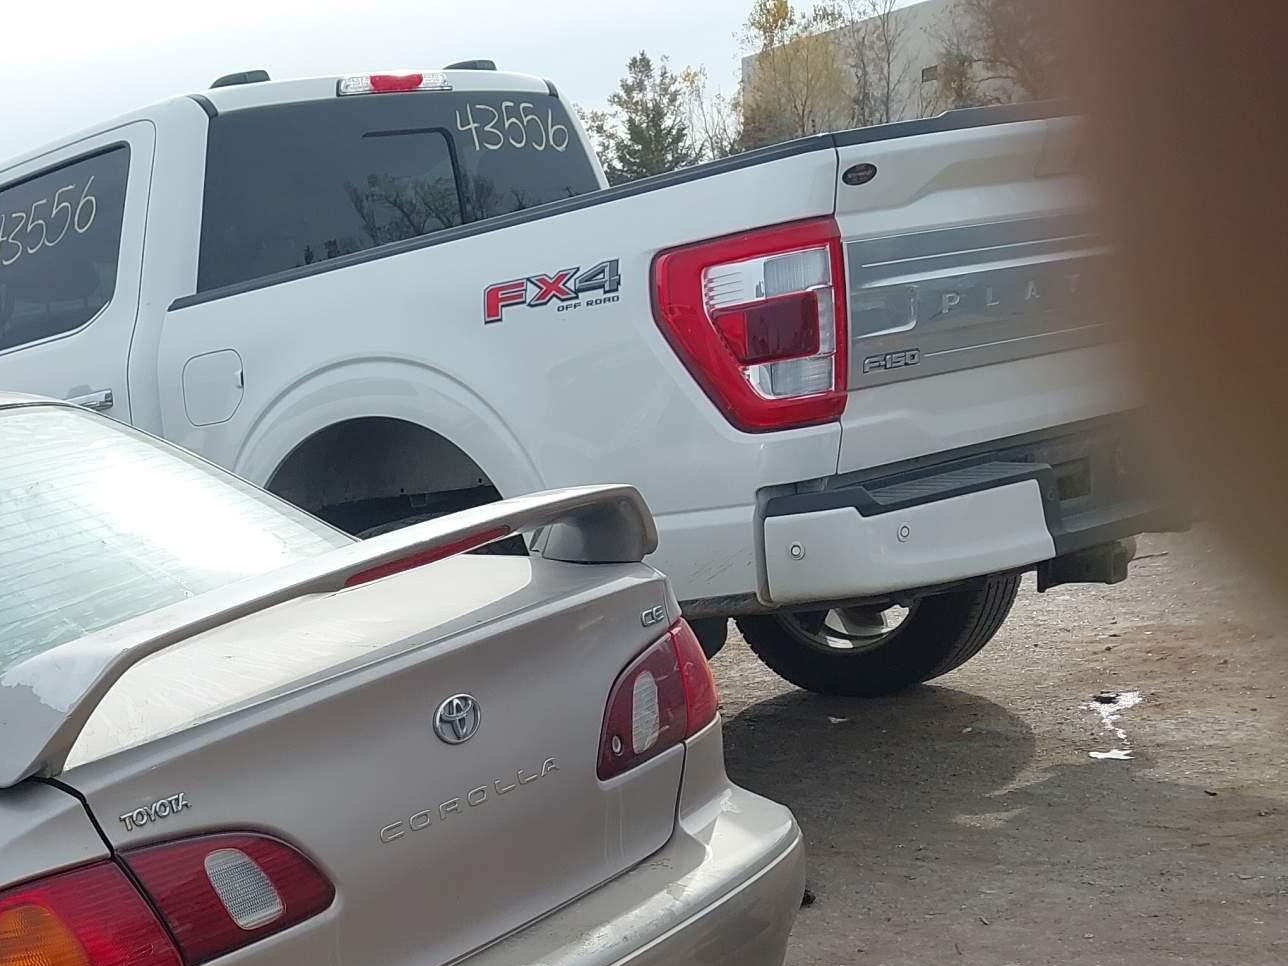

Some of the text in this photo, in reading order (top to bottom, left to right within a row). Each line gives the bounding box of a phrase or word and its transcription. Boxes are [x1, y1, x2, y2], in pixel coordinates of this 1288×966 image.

[455, 101, 569, 152] 43556
[483, 258, 621, 325] FX4
[556, 295, 620, 313] OFF ROAD
[863, 349, 920, 373] F-150
[641, 604, 665, 627] CE
[119, 792, 192, 831] TOYOTA
[379, 756, 560, 844] COROLLA
